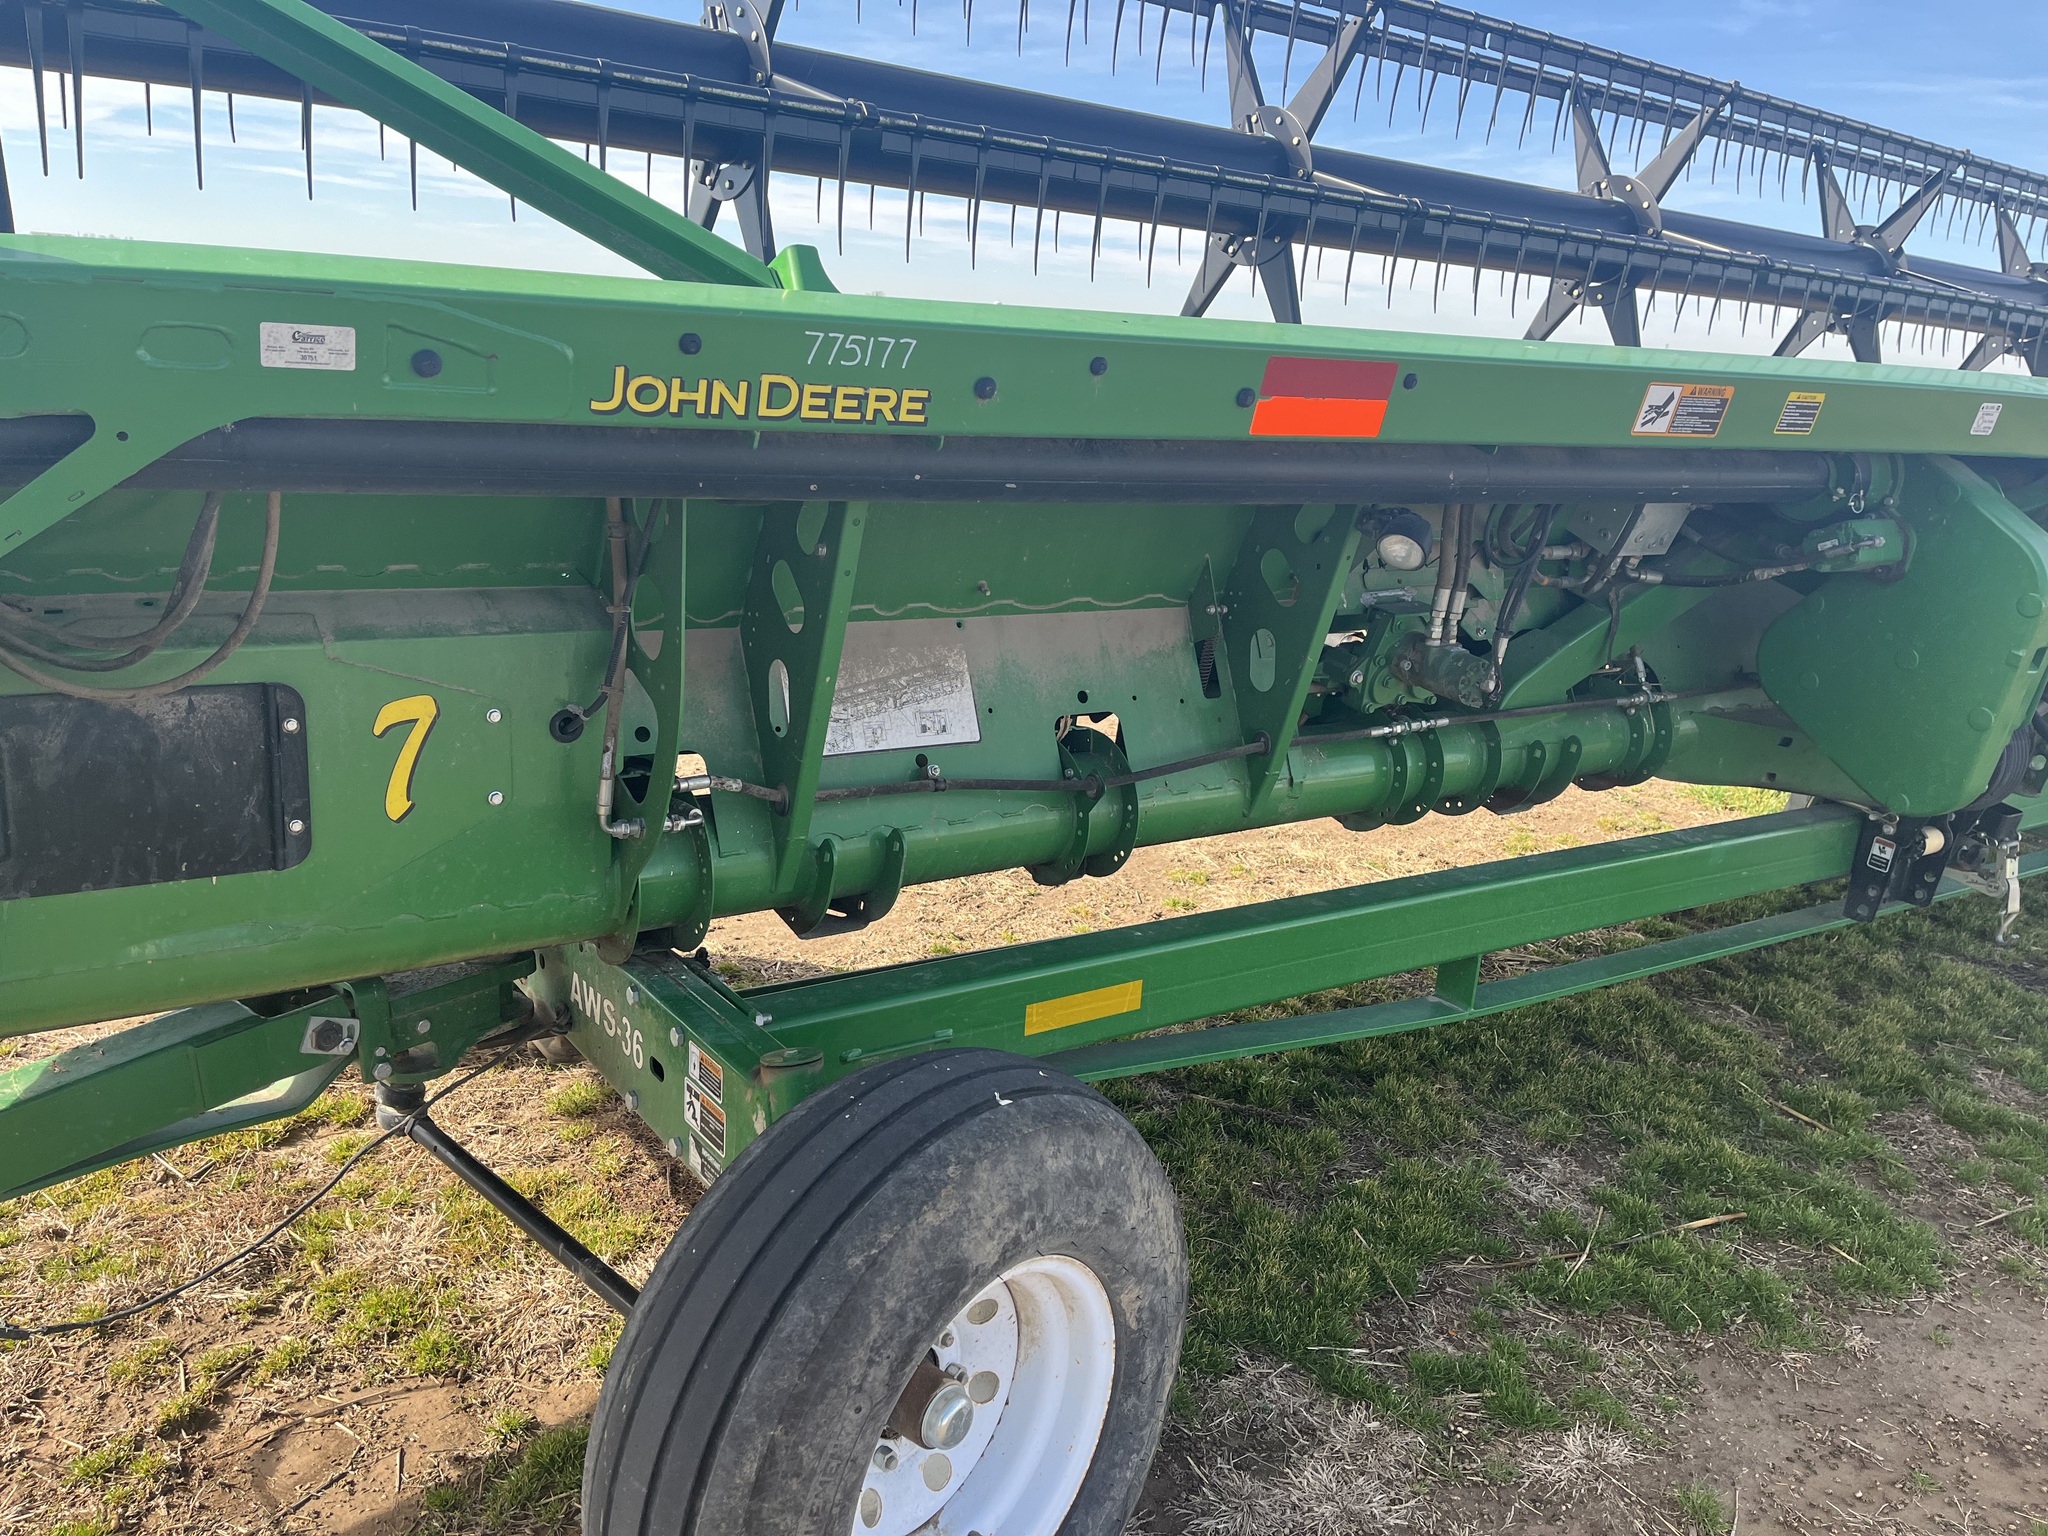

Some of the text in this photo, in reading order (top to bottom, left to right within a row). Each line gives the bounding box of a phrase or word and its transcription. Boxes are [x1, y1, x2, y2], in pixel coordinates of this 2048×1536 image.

[804, 330, 917, 369] 775177
[589, 364, 932, 426] JOHN DEERE
[1697, 387, 1727, 397] WARNING
[372, 694, 441, 824] 7
[570, 971, 644, 1070] AWS-36
